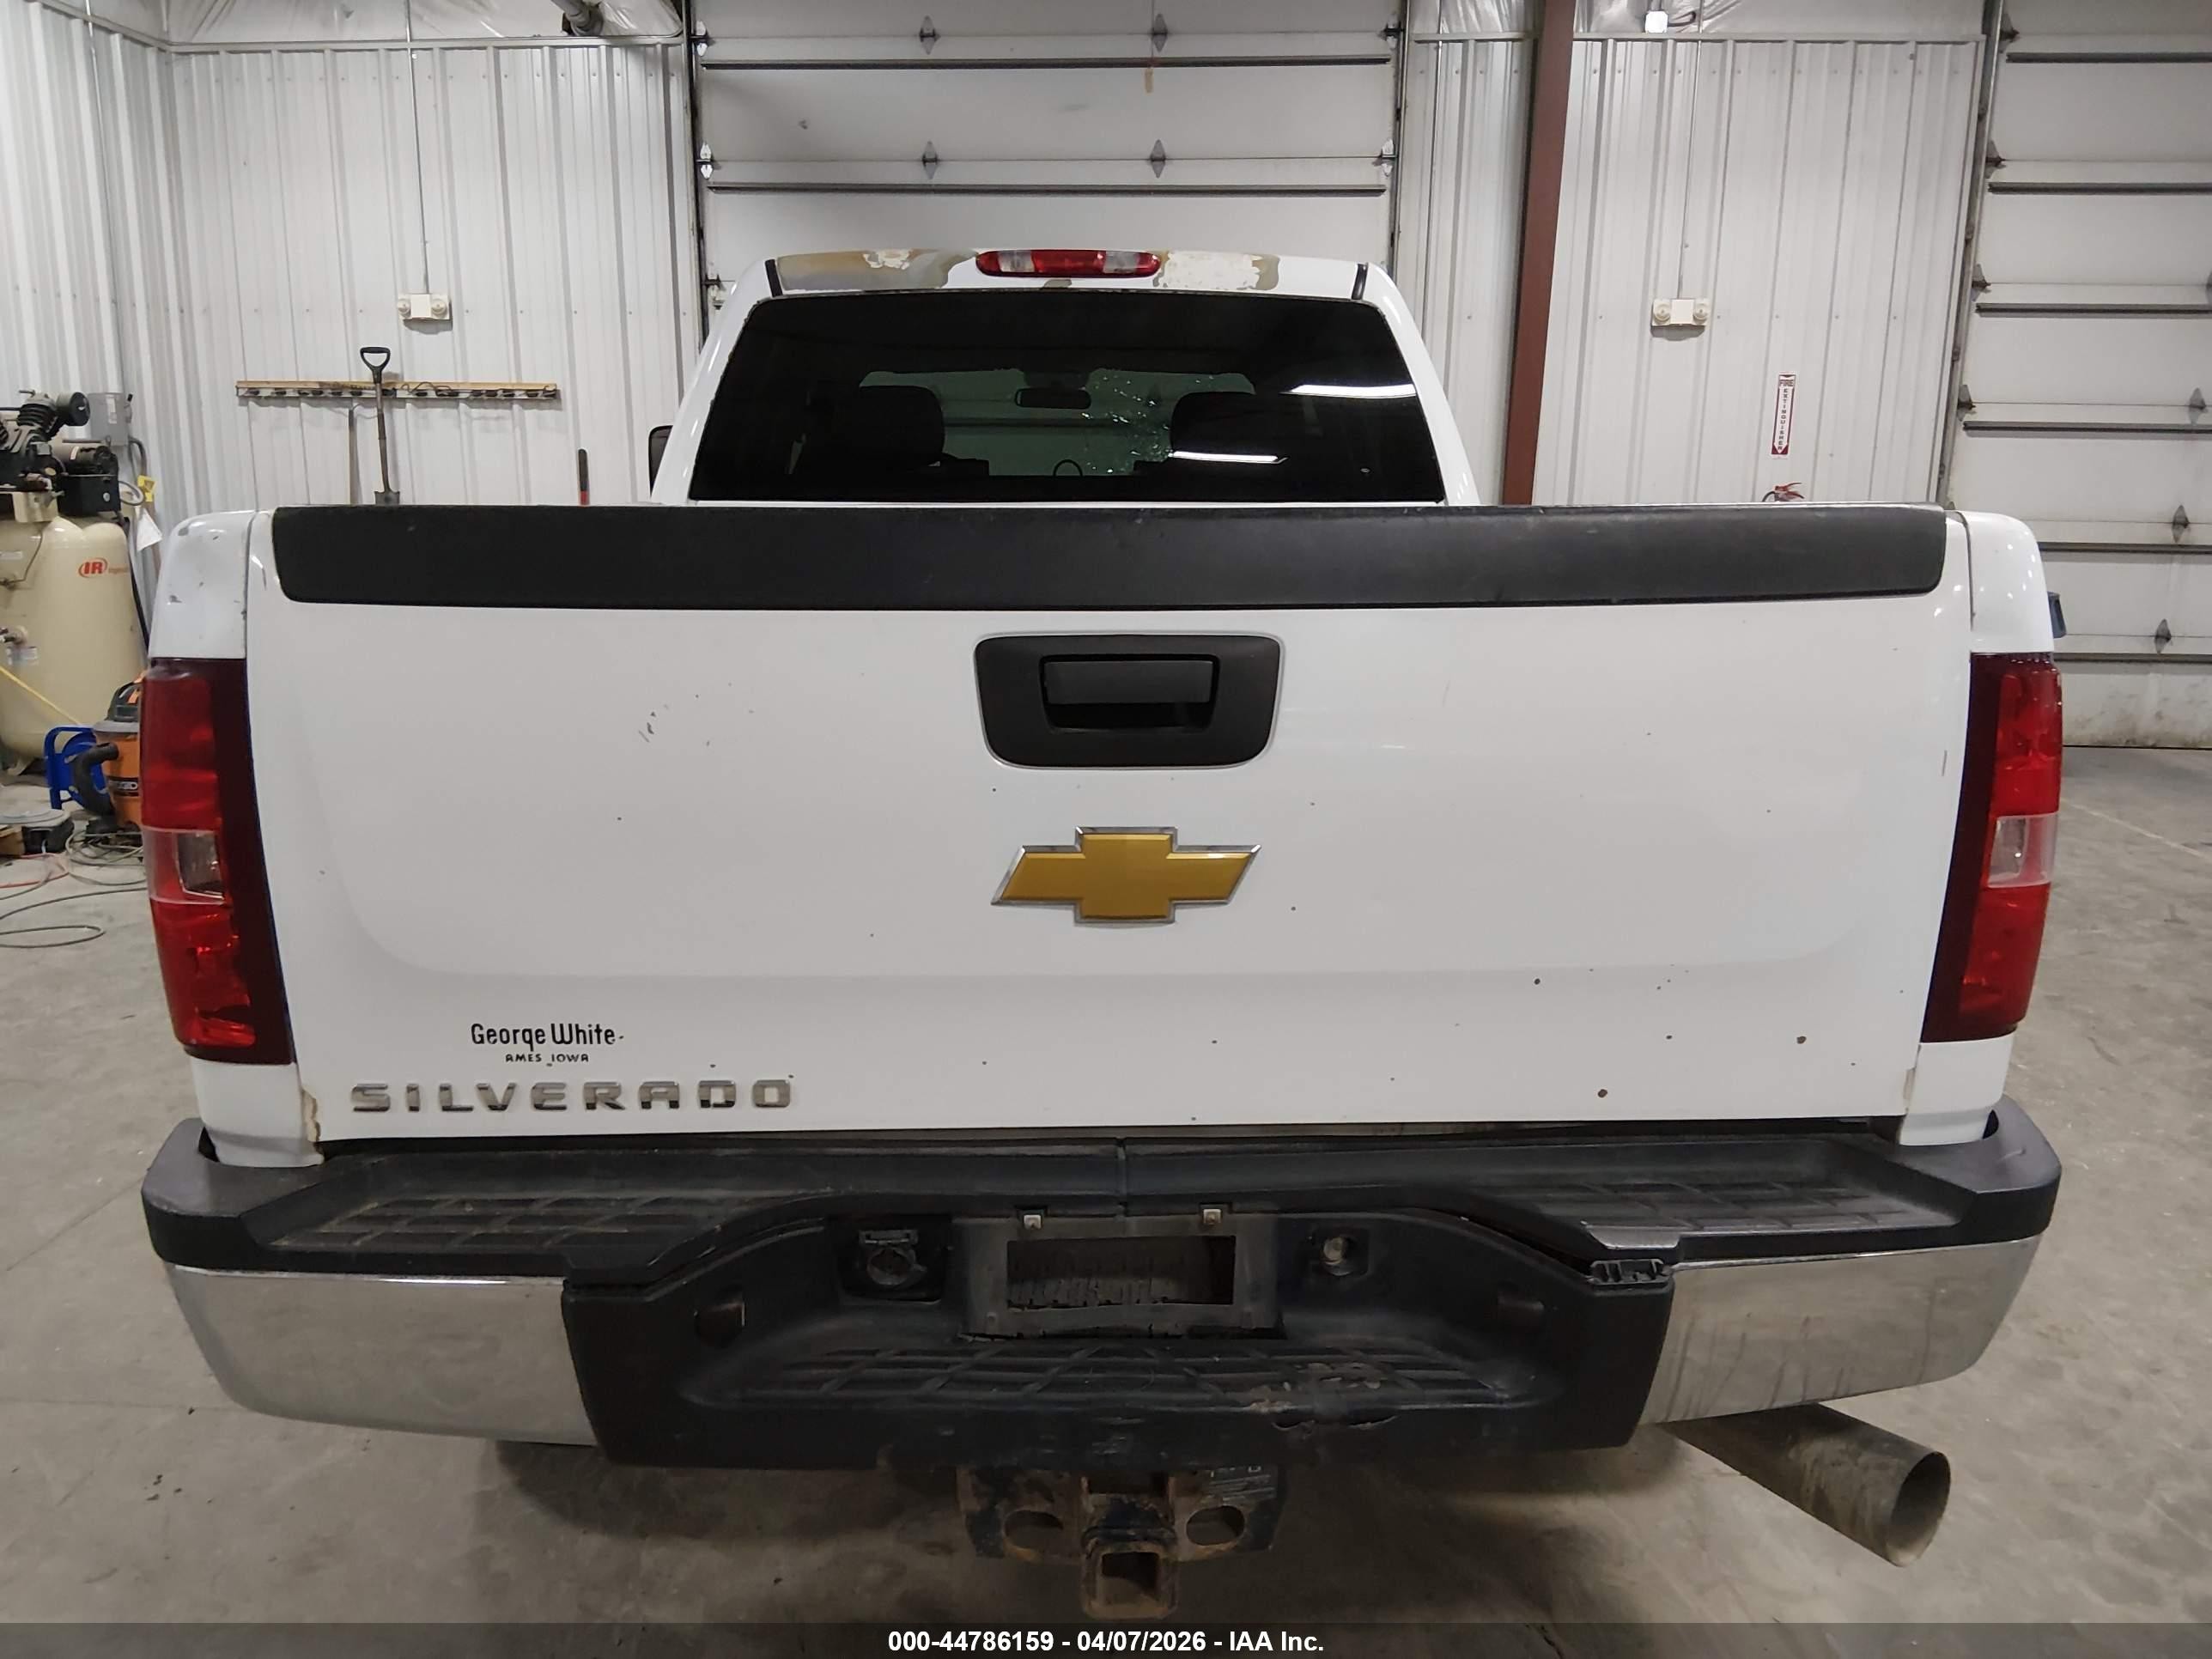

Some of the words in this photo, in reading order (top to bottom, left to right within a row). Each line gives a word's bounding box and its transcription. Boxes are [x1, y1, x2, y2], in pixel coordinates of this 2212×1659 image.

[1778, 388, 1789, 451] EXTINGUISHER
[471, 1023, 546, 1052] George
[551, 1023, 616, 1045] White
[505, 1053, 543, 1063] AMES
[551, 1053, 590, 1063] IOWA
[350, 1079, 793, 1112] SILVERADO
